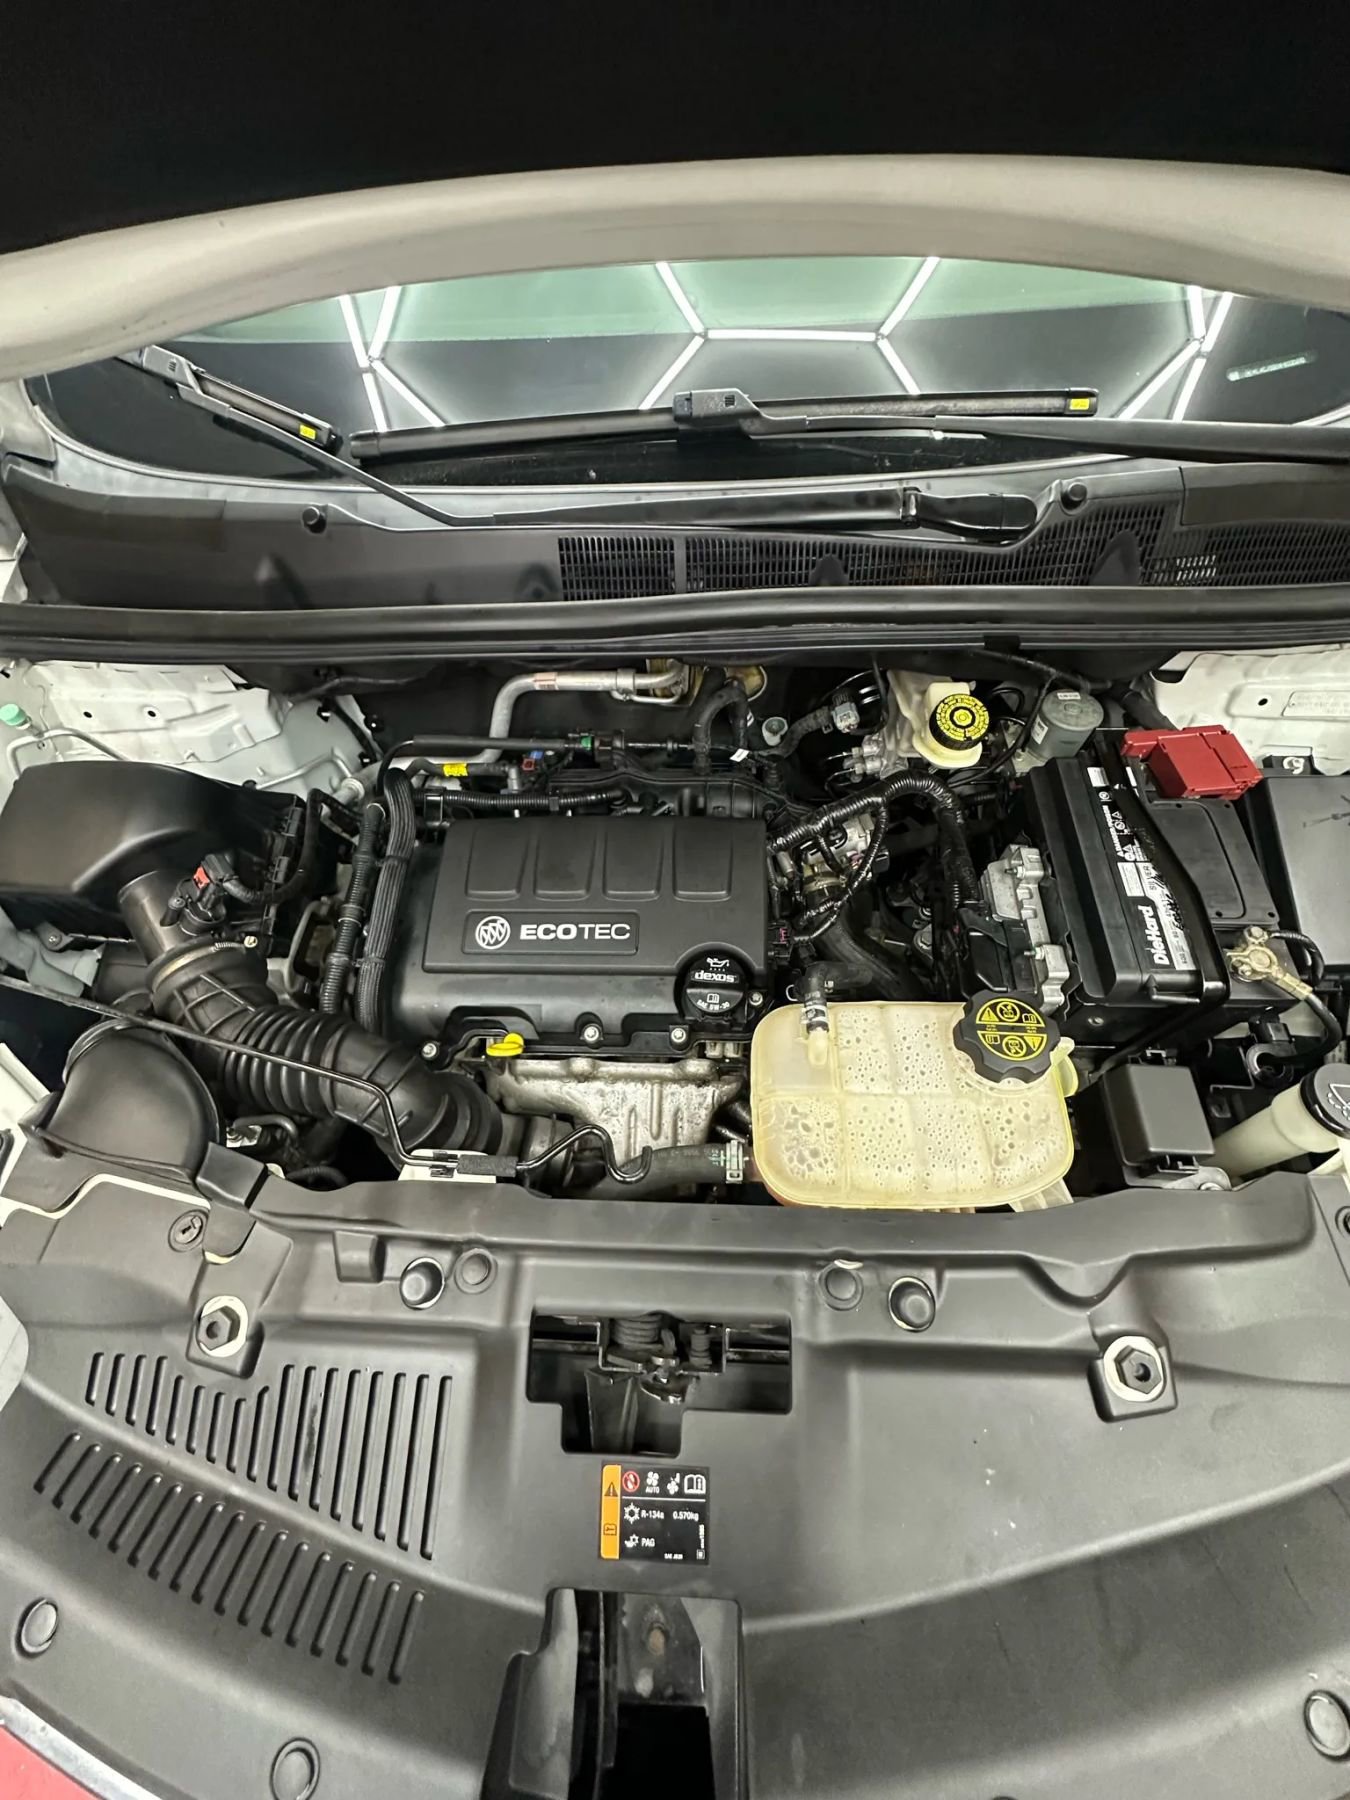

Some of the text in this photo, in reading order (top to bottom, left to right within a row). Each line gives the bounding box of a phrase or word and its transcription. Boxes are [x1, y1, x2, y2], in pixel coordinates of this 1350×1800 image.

[519, 923, 631, 940] ECOTEC
[1138, 904, 1170, 965] DieHard
[694, 970, 735, 983] dexos
[645, 1486, 660, 1494] AUTO
[641, 1511, 699, 1522] R-134a 0.570kg
[641, 1538, 655, 1547] PAG
